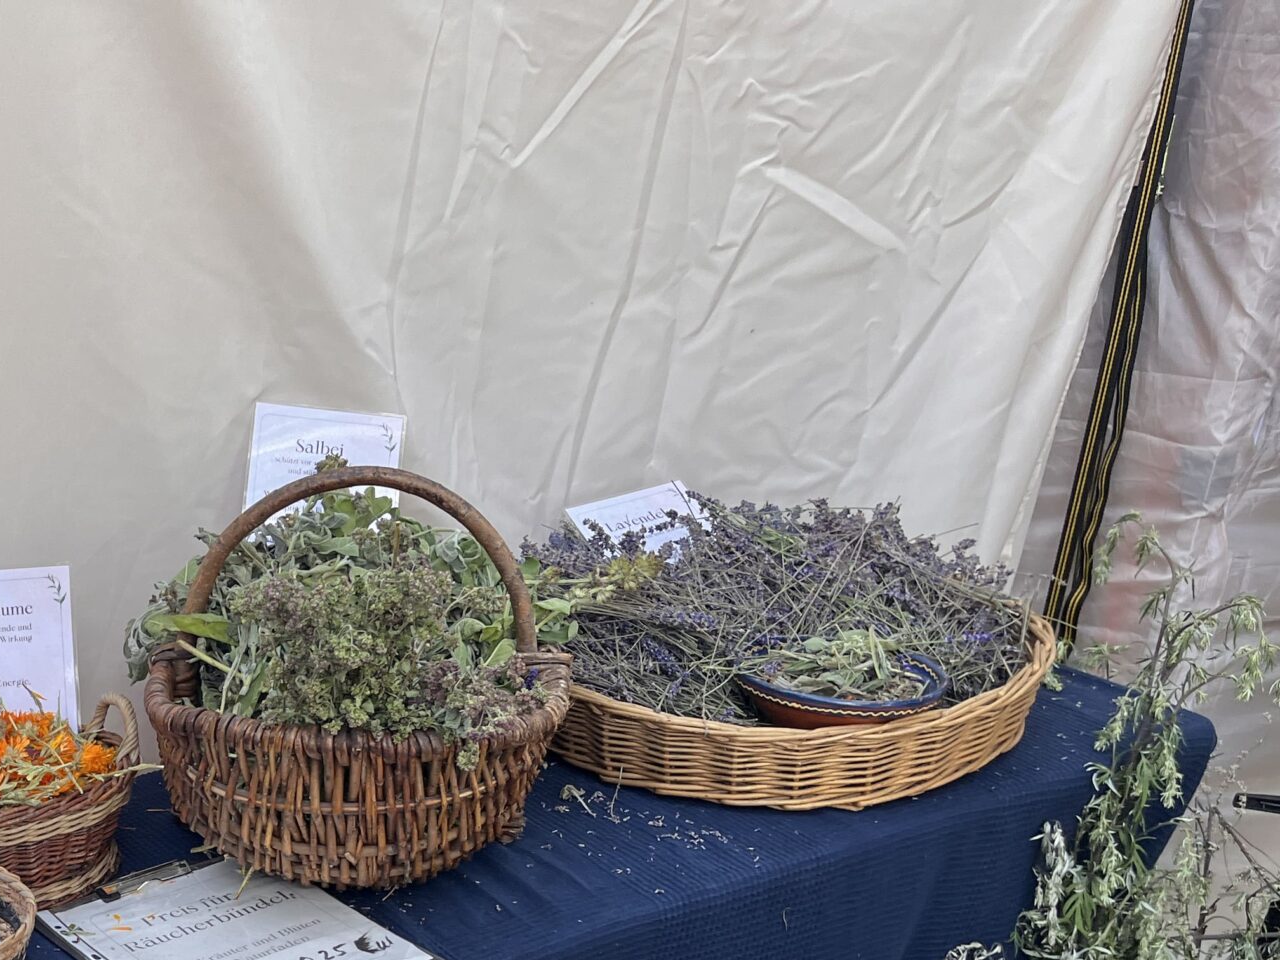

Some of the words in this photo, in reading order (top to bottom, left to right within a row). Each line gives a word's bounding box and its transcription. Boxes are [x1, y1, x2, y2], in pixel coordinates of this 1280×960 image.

[295, 438, 344, 457] Salbei
[605, 507, 668, 533] Lavendel
[0, 634, 33, 645] Wirkung
[17, 622, 33, 632] und
[202, 890, 234, 915] für
[120, 890, 297, 953] Räucherbündel:
[252, 934, 277, 949] und
[277, 918, 321, 937] Blüten
